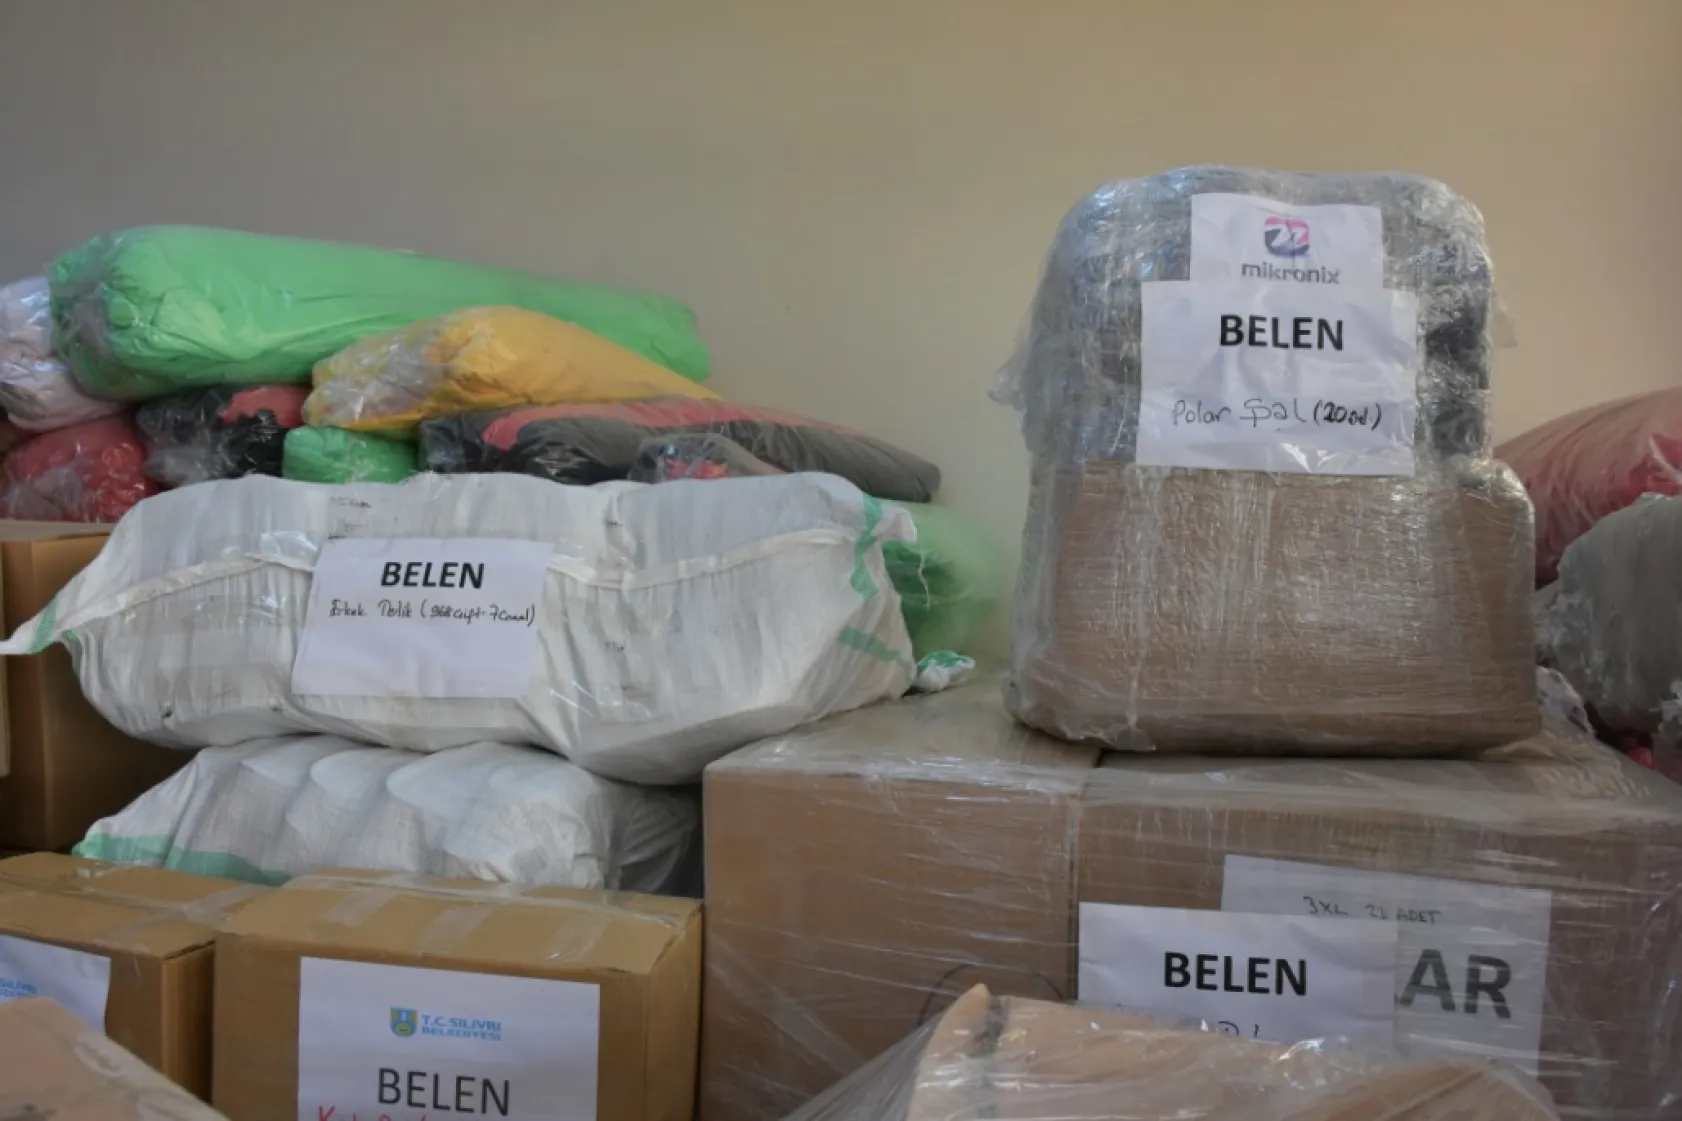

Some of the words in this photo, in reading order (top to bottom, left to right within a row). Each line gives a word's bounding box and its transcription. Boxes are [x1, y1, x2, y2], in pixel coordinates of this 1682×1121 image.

[1241, 262, 1340, 285] mikronix
[1219, 314, 1344, 351] BELEN
[1171, 400, 1232, 426] Polar
[380, 561, 485, 589] BELEN
[1164, 951, 1307, 996] BELEN
[378, 1067, 510, 1117] BELEN
